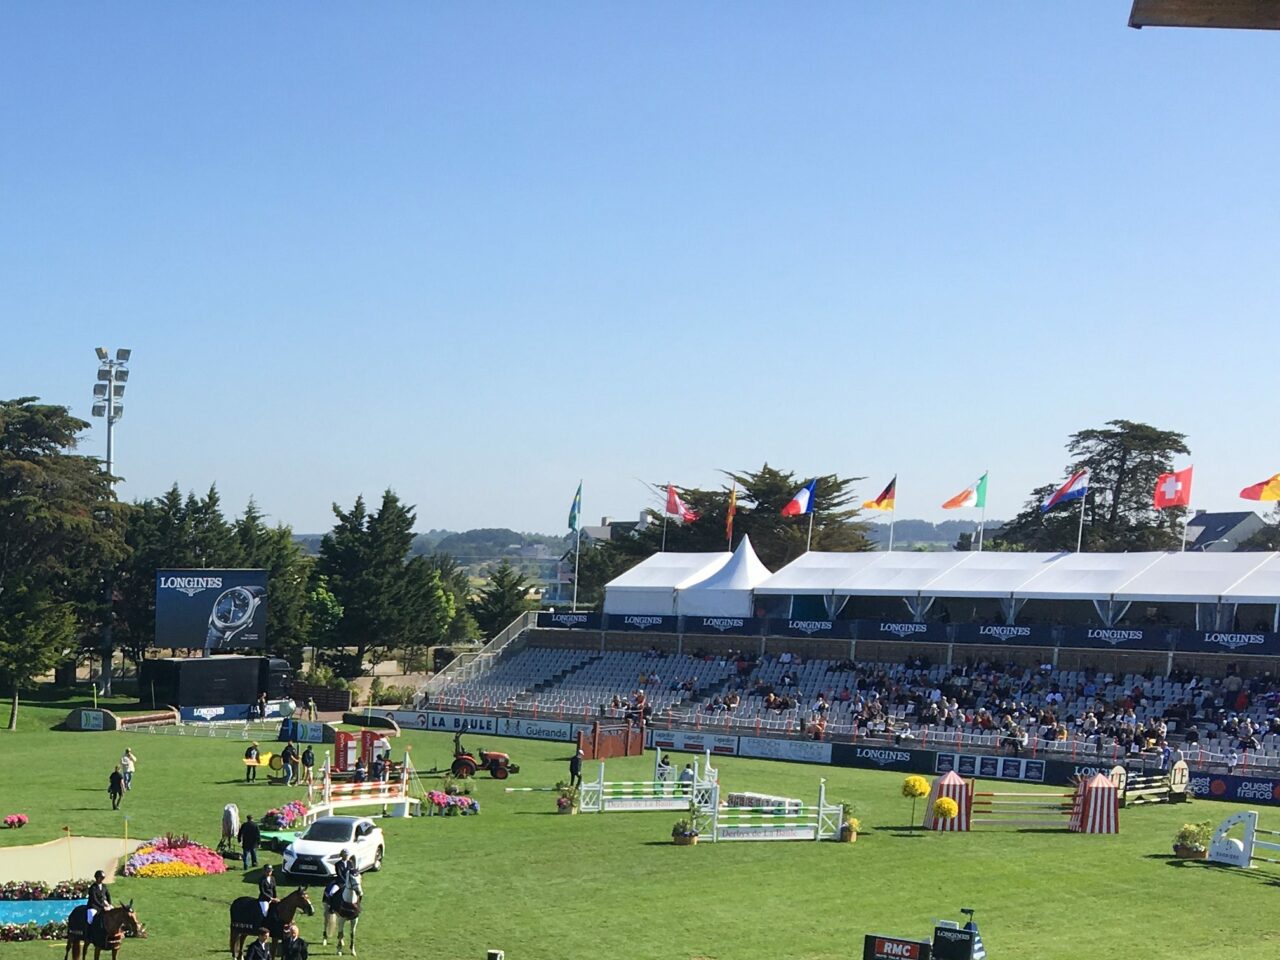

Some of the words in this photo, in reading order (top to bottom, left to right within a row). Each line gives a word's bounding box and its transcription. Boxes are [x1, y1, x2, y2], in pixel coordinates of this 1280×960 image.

[160, 577, 222, 588] LONGINES
[552, 615, 588, 623] LONGINES
[625, 617, 663, 625] LONGINES
[703, 618, 744, 627] LONGINES
[789, 621, 832, 630] LONGINES
[880, 623, 927, 632] LONGINES
[980, 626, 1031, 636] LONGINES
[1088, 630, 1143, 640] LONGINES
[1205, 633, 1265, 644] LONGINES
[432, 717, 445, 727] LA
[454, 719, 493, 731] BAULE
[526, 727, 567, 738] Guérande
[856, 749, 911, 761] LONGINES
[1241, 781, 1273, 792] ouest
[1237, 787, 1273, 800] france
[884, 941, 911, 957] RMC
